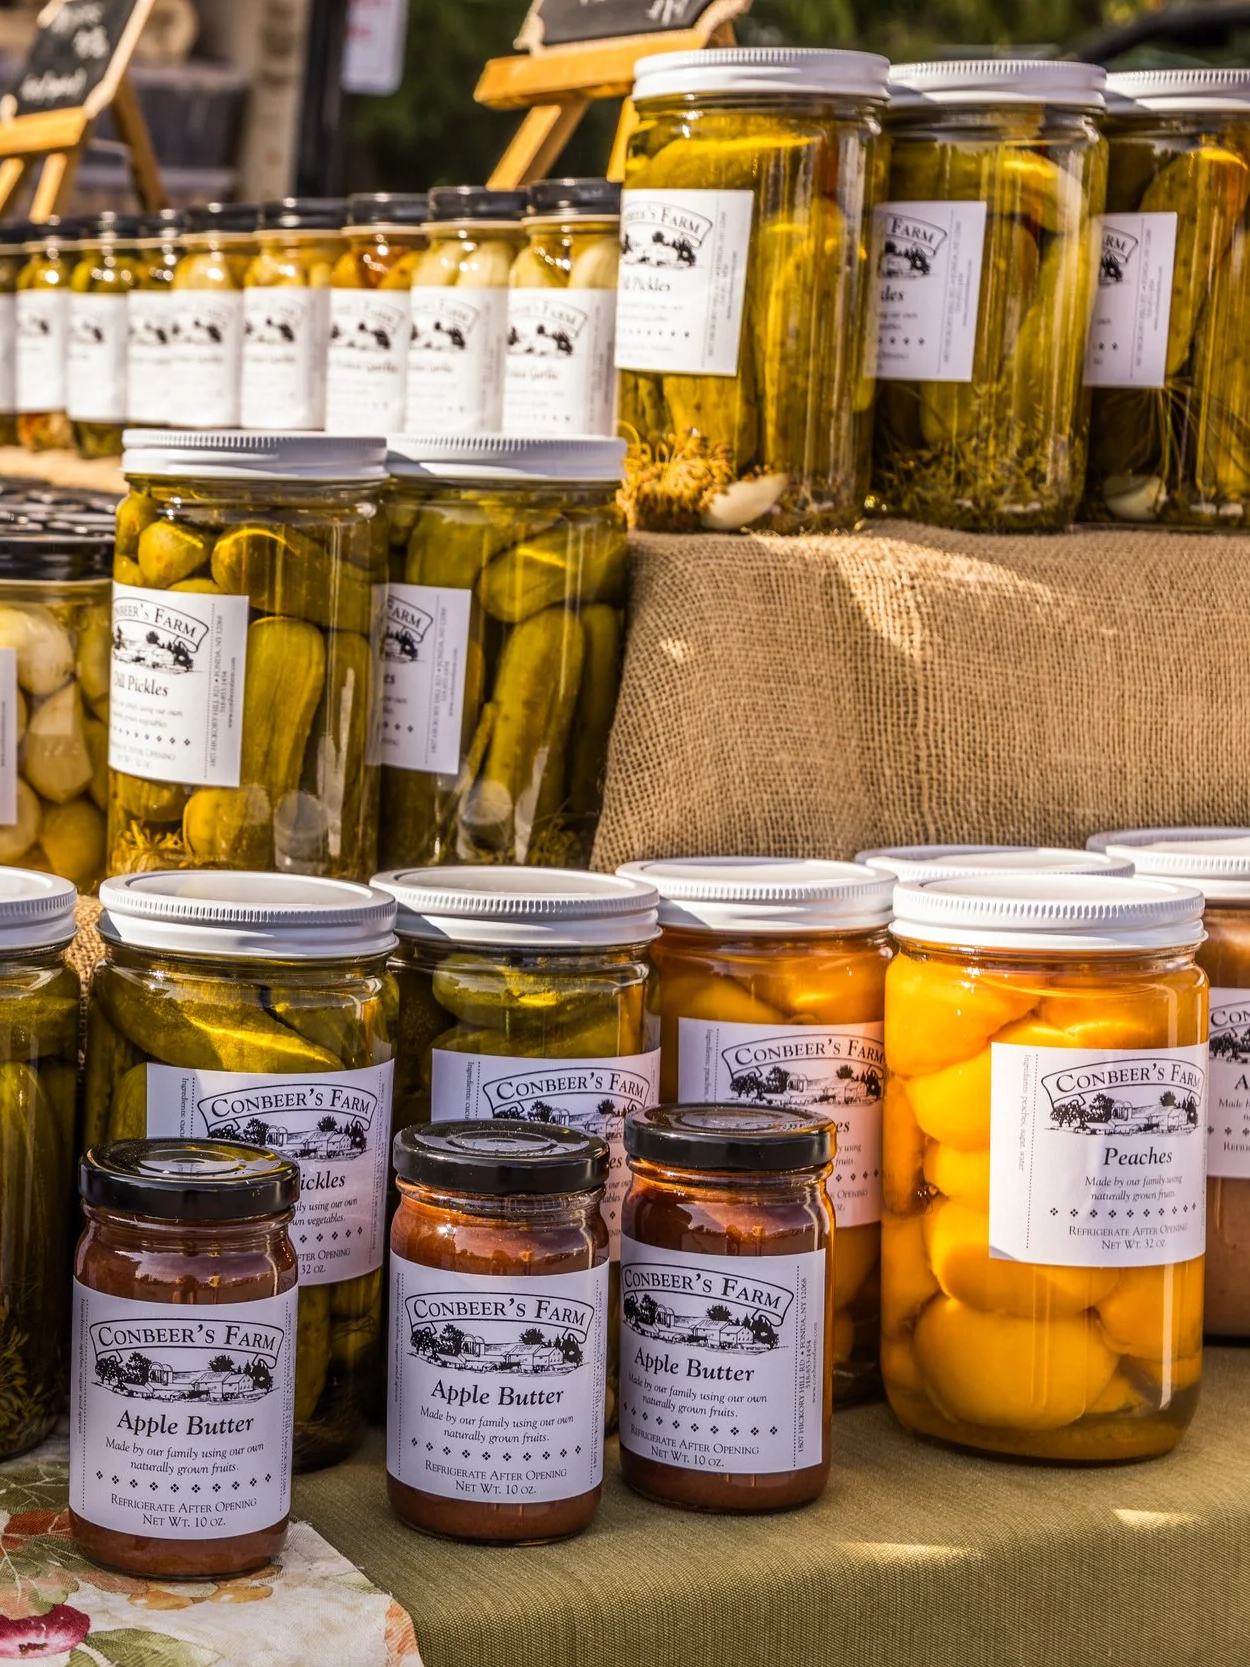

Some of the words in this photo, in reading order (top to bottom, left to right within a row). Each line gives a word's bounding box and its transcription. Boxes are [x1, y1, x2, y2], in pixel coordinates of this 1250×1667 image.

[662, 207, 700, 234] FARM
[891, 217, 934, 244] FARM
[154, 607, 196, 638] FARM
[128, 675, 168, 696] Pickles
[735, 1038, 841, 1066] CONBEER'S
[848, 1039, 884, 1063] FARM
[465, 1061, 475, 1101] Ingredients:
[496, 1072, 603, 1100] CONBEER'S
[609, 1072, 645, 1099] FARM
[1056, 1063, 1164, 1093] CONBEER'S
[1170, 1063, 1201, 1090] FARM
[180, 1078, 190, 1118] Ingredients:
[211, 1088, 324, 1117] CONBEER'S
[330, 1089, 370, 1115] FARM
[1103, 1148, 1173, 1166] Peaches
[300, 1171, 346, 1191] ickles
[1085, 1177, 1112, 1187] Made
[1114, 1176, 1124, 1188] by
[1126, 1178, 1140, 1186] our
[1142, 1175, 1165, 1188] family
[309, 1202, 329, 1212] using
[331, 1201, 342, 1209] our
[344, 1198, 358, 1207] own
[1091, 1191, 1131, 1202] naturally
[1132, 1192, 1156, 1202] grown
[308, 1212, 346, 1227] vegetables.
[297, 1252, 316, 1261] FTER
[318, 1248, 351, 1260] OPENING
[1144, 1238, 1154, 1249] 32
[301, 1264, 311, 1274] 32
[624, 1269, 712, 1294] CONBEER'S
[721, 1277, 781, 1310] FARM
[413, 1298, 526, 1319] CONBEER'S
[534, 1299, 586, 1327] FARM
[800, 1302, 806, 1314] NY
[98, 1323, 215, 1347] CONBEER'S
[223, 1325, 277, 1351] FARM
[634, 1346, 679, 1375] Apple
[686, 1359, 755, 1382] Butter
[431, 1379, 490, 1408] Apple
[498, 1386, 564, 1406] Butter
[644, 1378, 652, 1391] by
[654, 1383, 667, 1394] our
[669, 1386, 697, 1402] family
[700, 1391, 725, 1404] using
[727, 1395, 745, 1403] our
[746, 1395, 767, 1403] own
[420, 1405, 444, 1421] Made
[446, 1412, 457, 1426] by
[460, 1416, 476, 1427] our
[478, 1415, 510, 1429] family
[513, 1416, 538, 1430] using
[540, 1417, 556, 1427] our
[557, 1415, 574, 1425] own
[643, 1394, 676, 1412] naturally
[678, 1404, 706, 1416] grown
[708, 1407, 738, 1419] fruits.
[117, 1409, 178, 1438] Apple
[186, 1414, 254, 1436] Butter
[105, 1436, 130, 1453] Made
[132, 1443, 144, 1457] by
[147, 1447, 164, 1458] our
[166, 1445, 199, 1460] family
[201, 1446, 227, 1460] using
[229, 1445, 246, 1456] our
[246, 1442, 264, 1454] own
[443, 1428, 486, 1444] naturally
[488, 1433, 520, 1445] grown
[521, 1431, 550, 1446] fruits.
[631, 1424, 676, 1448] REFRIGERATE
[679, 1440, 710, 1452] AFTER
[713, 1443, 759, 1455] OPENING
[130, 1460, 174, 1475] naturally
[177, 1464, 209, 1476] grown
[210, 1462, 239, 1475] fruits.
[651, 1446, 669, 1460] NET
[671, 1450, 690, 1464] WT.
[693, 1454, 705, 1466] 10
[425, 1459, 487, 1480] REFRIGERATE
[489, 1469, 523, 1481] AFTER
[526, 1469, 567, 1481] OPENING
[455, 1480, 477, 1493] NET
[480, 1482, 501, 1495] WT.
[506, 1483, 518, 1495] 10
[111, 1493, 175, 1512] REFRIGERATE
[178, 1502, 212, 1514] AFTER
[215, 1497, 257, 1513] OPENING
[142, 1514, 165, 1527] NET
[168, 1515, 190, 1528] WT.
[195, 1516, 207, 1528] 10
